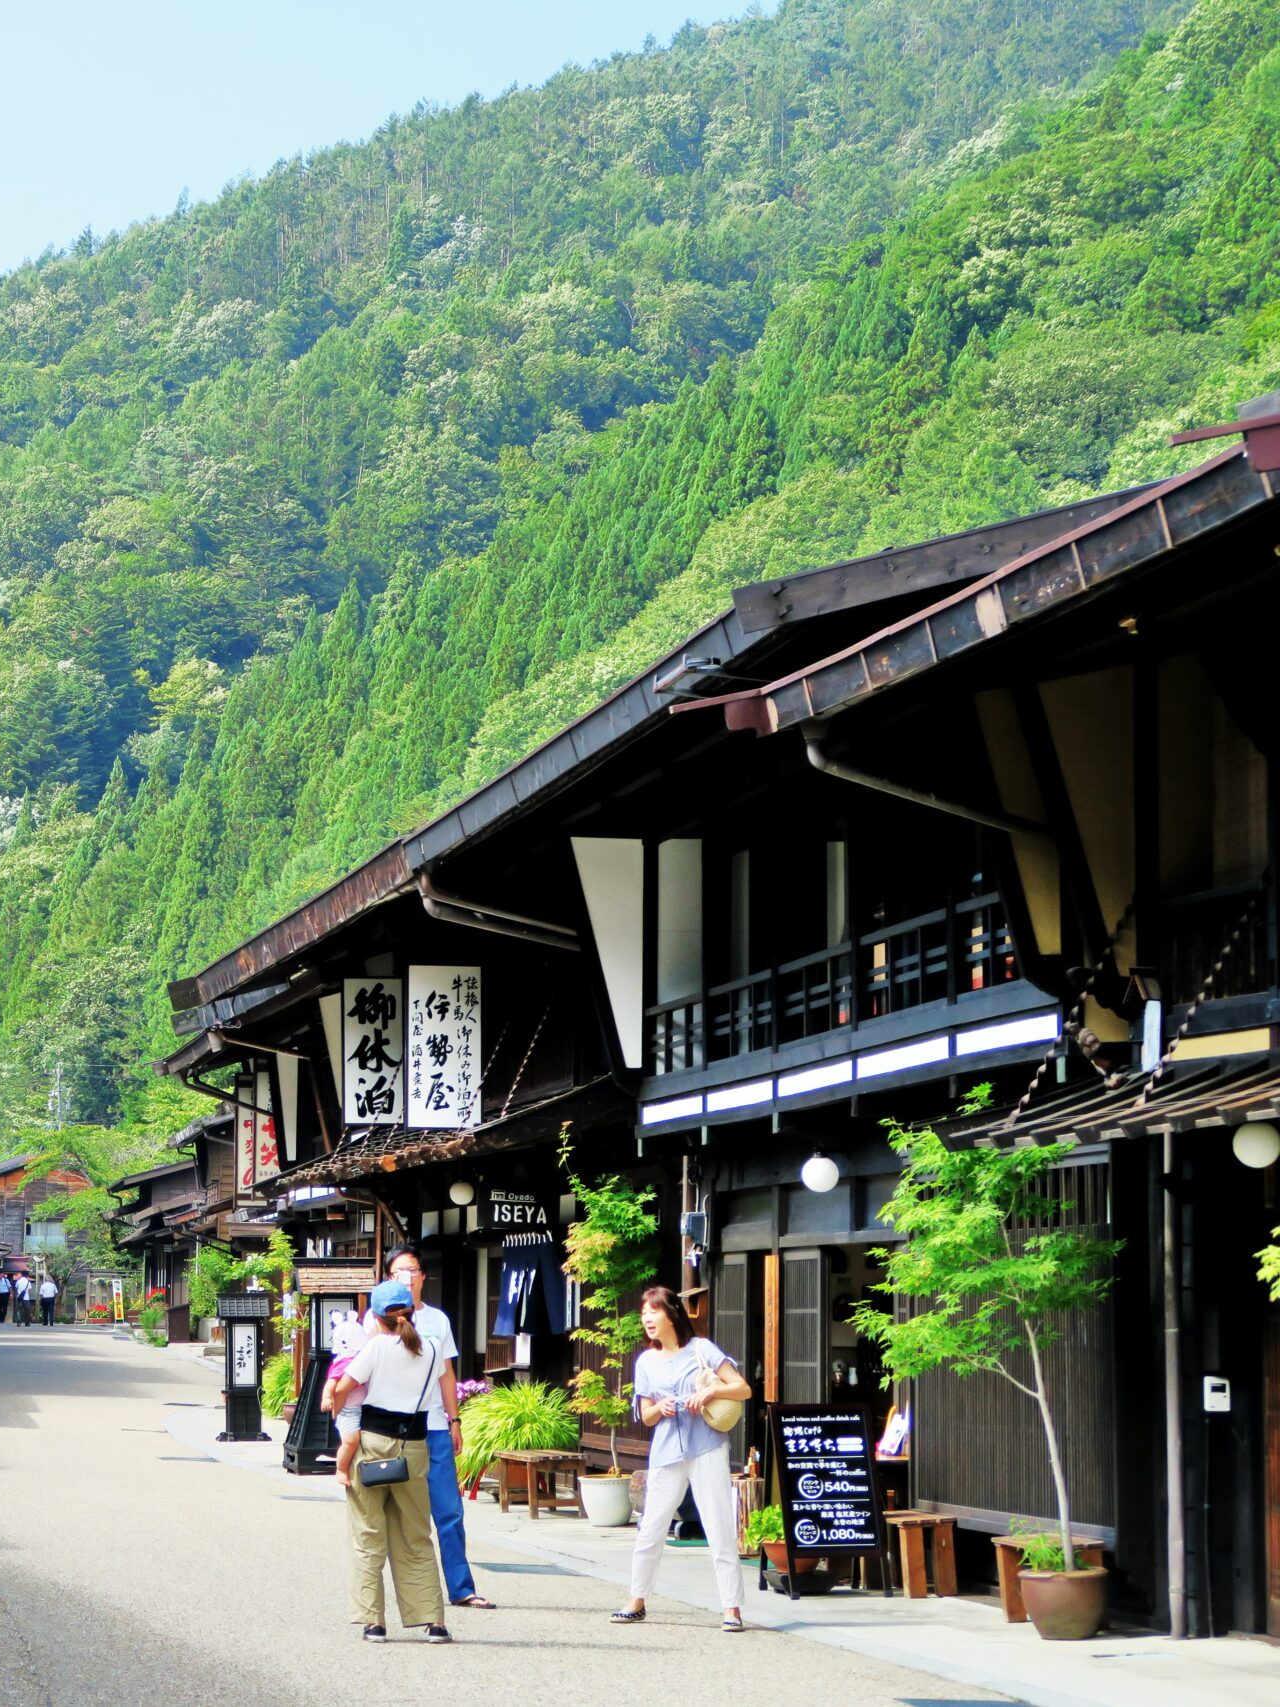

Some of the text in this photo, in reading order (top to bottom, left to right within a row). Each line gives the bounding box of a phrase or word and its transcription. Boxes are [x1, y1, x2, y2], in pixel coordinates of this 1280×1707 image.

[425, 990, 455, 1111] 伊勢屋
[508, 1192, 535, 1201] Oyado
[494, 1203, 548, 1225] ISEYA
